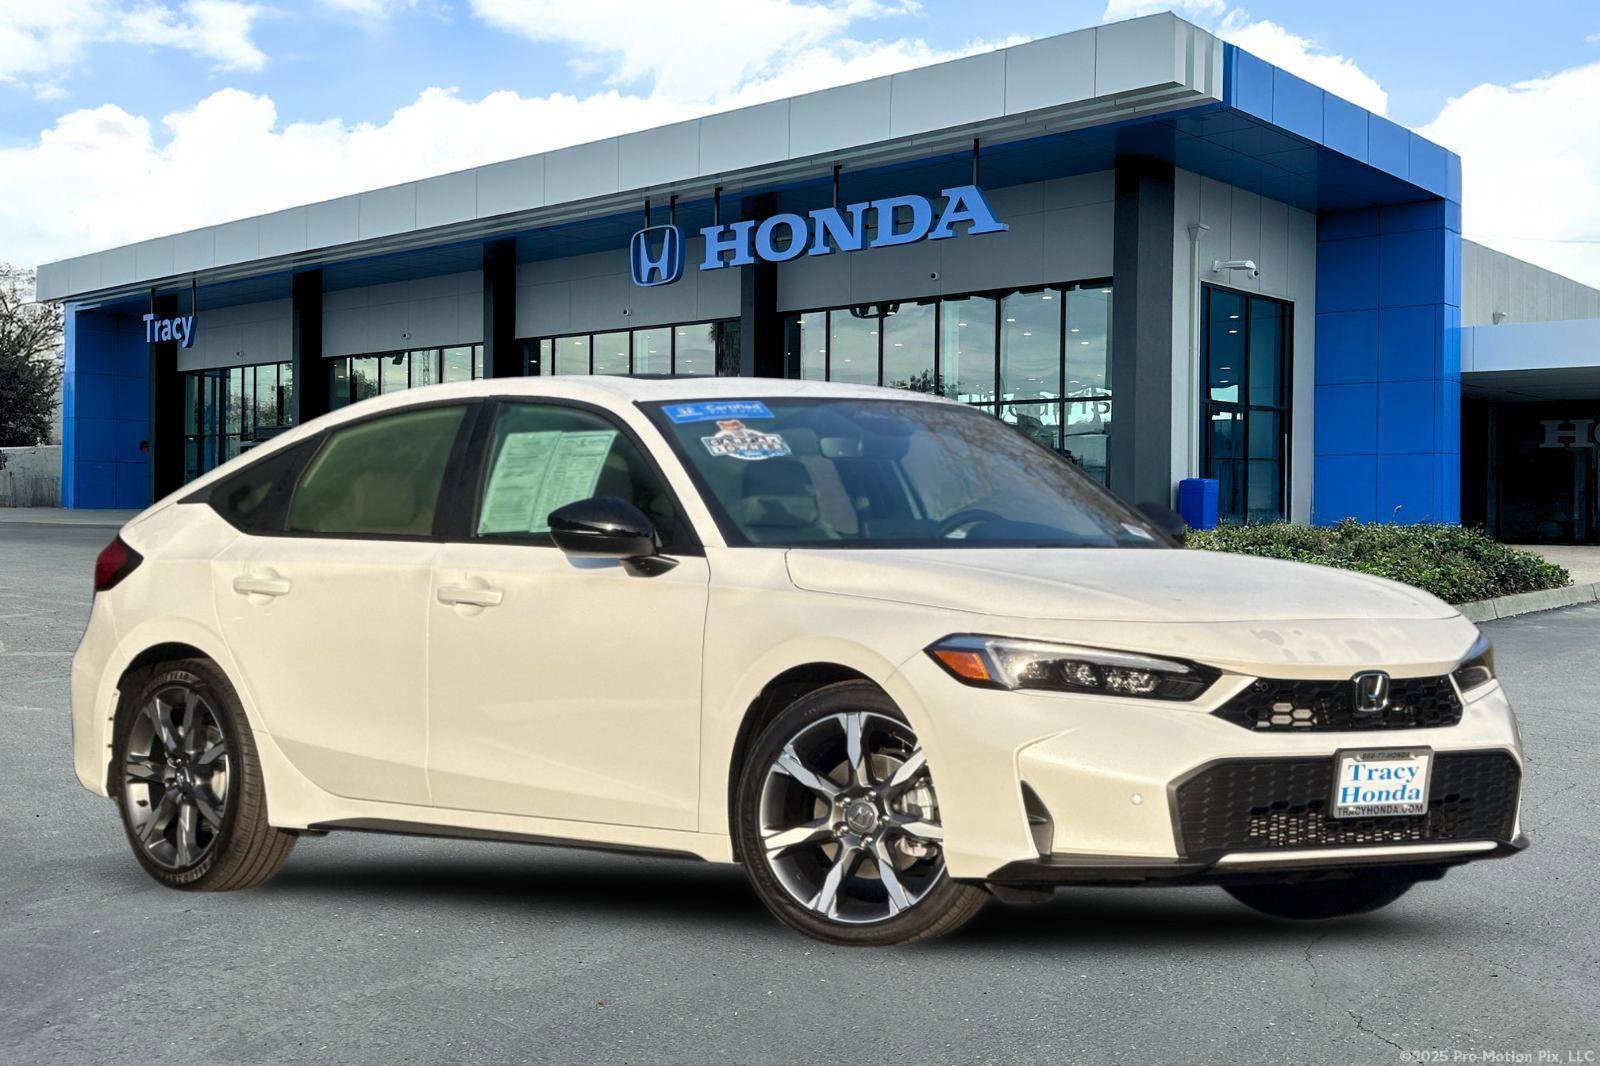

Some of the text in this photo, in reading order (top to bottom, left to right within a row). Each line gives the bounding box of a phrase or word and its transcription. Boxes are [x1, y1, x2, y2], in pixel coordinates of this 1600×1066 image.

[700, 185, 1009, 271] HONDA
[143, 313, 194, 348] Tracy
[1539, 419, 1600, 448] H
[1348, 764, 1420, 783] Tracy
[1341, 784, 1420, 803] Honda
